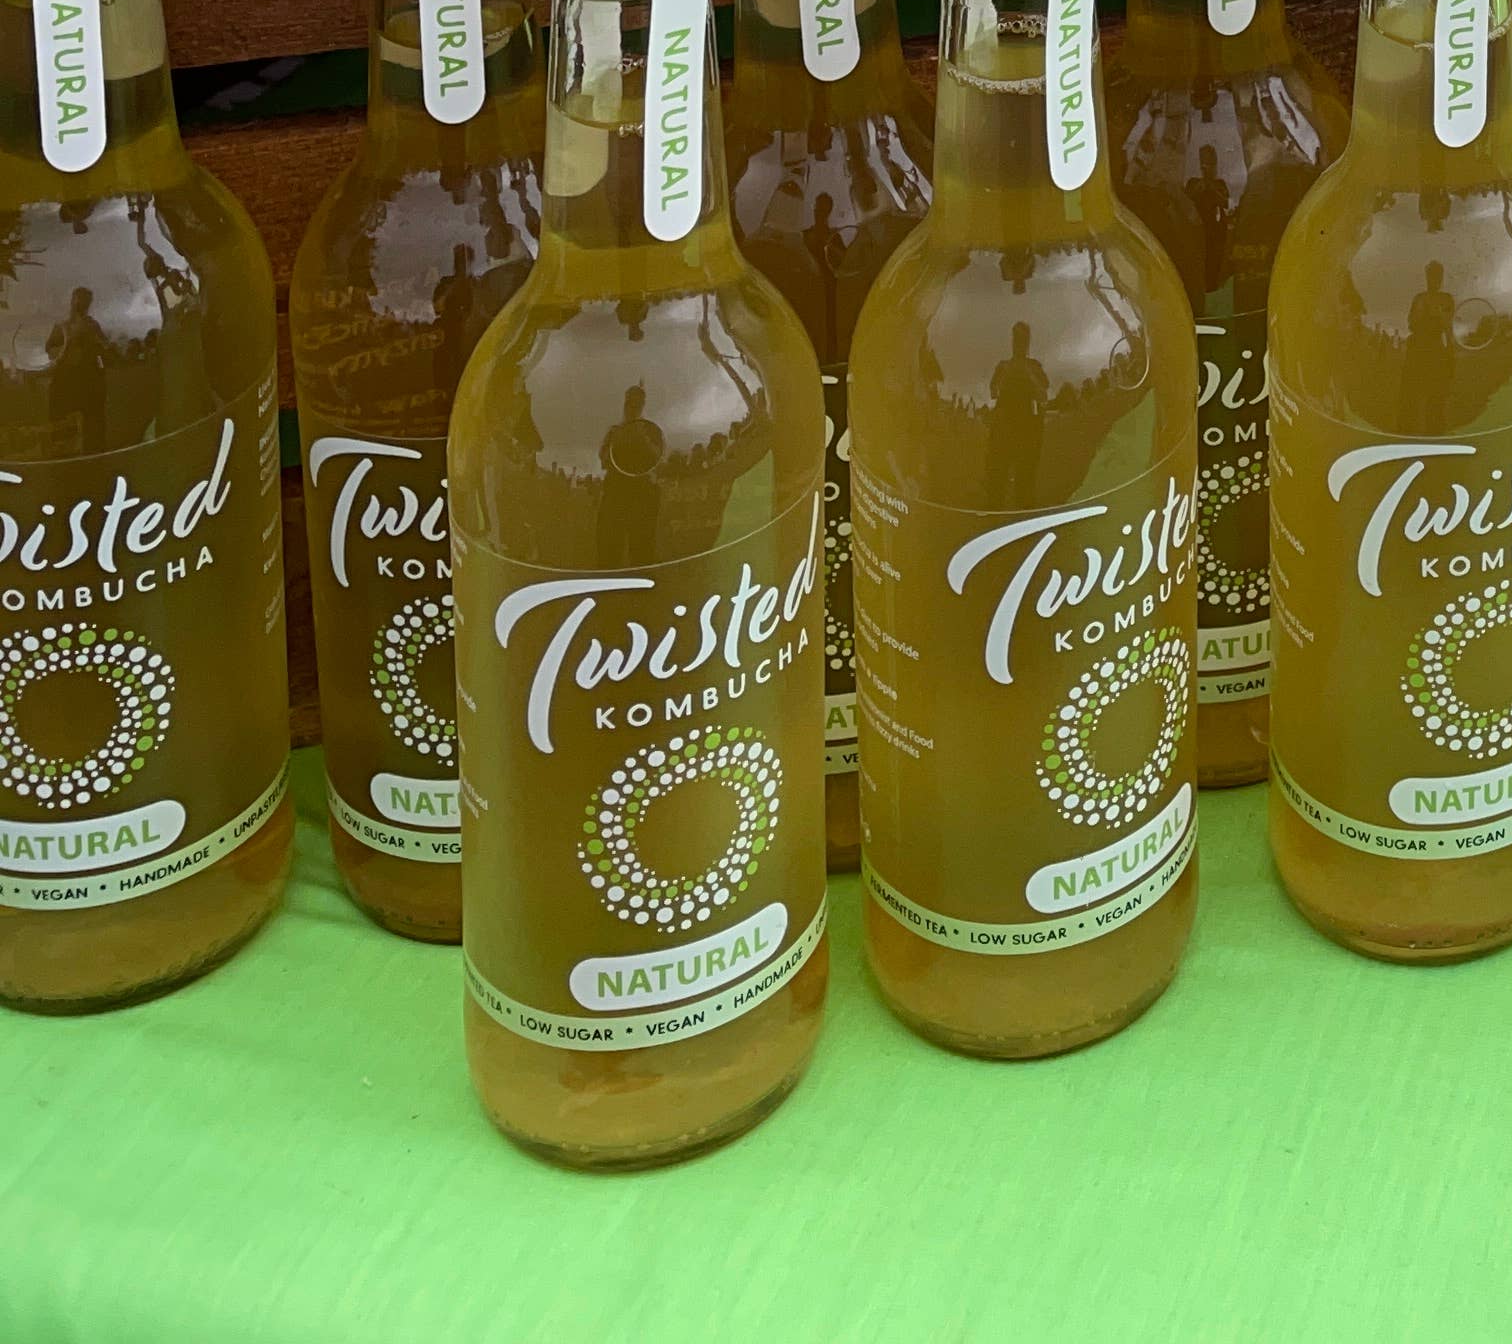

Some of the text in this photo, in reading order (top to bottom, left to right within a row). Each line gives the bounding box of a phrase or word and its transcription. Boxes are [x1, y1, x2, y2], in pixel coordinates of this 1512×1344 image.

[660, 27, 692, 211] NATURAL
[2, 545, 214, 612] OMBUCHA
[494, 491, 819, 755] Twisted
[1054, 542, 1195, 653] KOMBUCH
[595, 627, 808, 730] KOMBUCHA
[1216, 677, 1265, 696] VEGAN
[31, 846, 210, 900] VEGAN HANDMADE
[1050, 806, 1186, 901] NATURAL
[596, 926, 768, 998] NATURAL
[925, 918, 948, 937] TEA
[970, 932, 1005, 945] LOW
[1012, 927, 1067, 945] SUGAR
[1096, 894, 1142, 926] VEGAN
[519, 1013, 554, 1039] LOW
[558, 1023, 614, 1041] SUGAR
[646, 1010, 705, 1035] VEGAN
[733, 947, 804, 1009] HANDMADE
